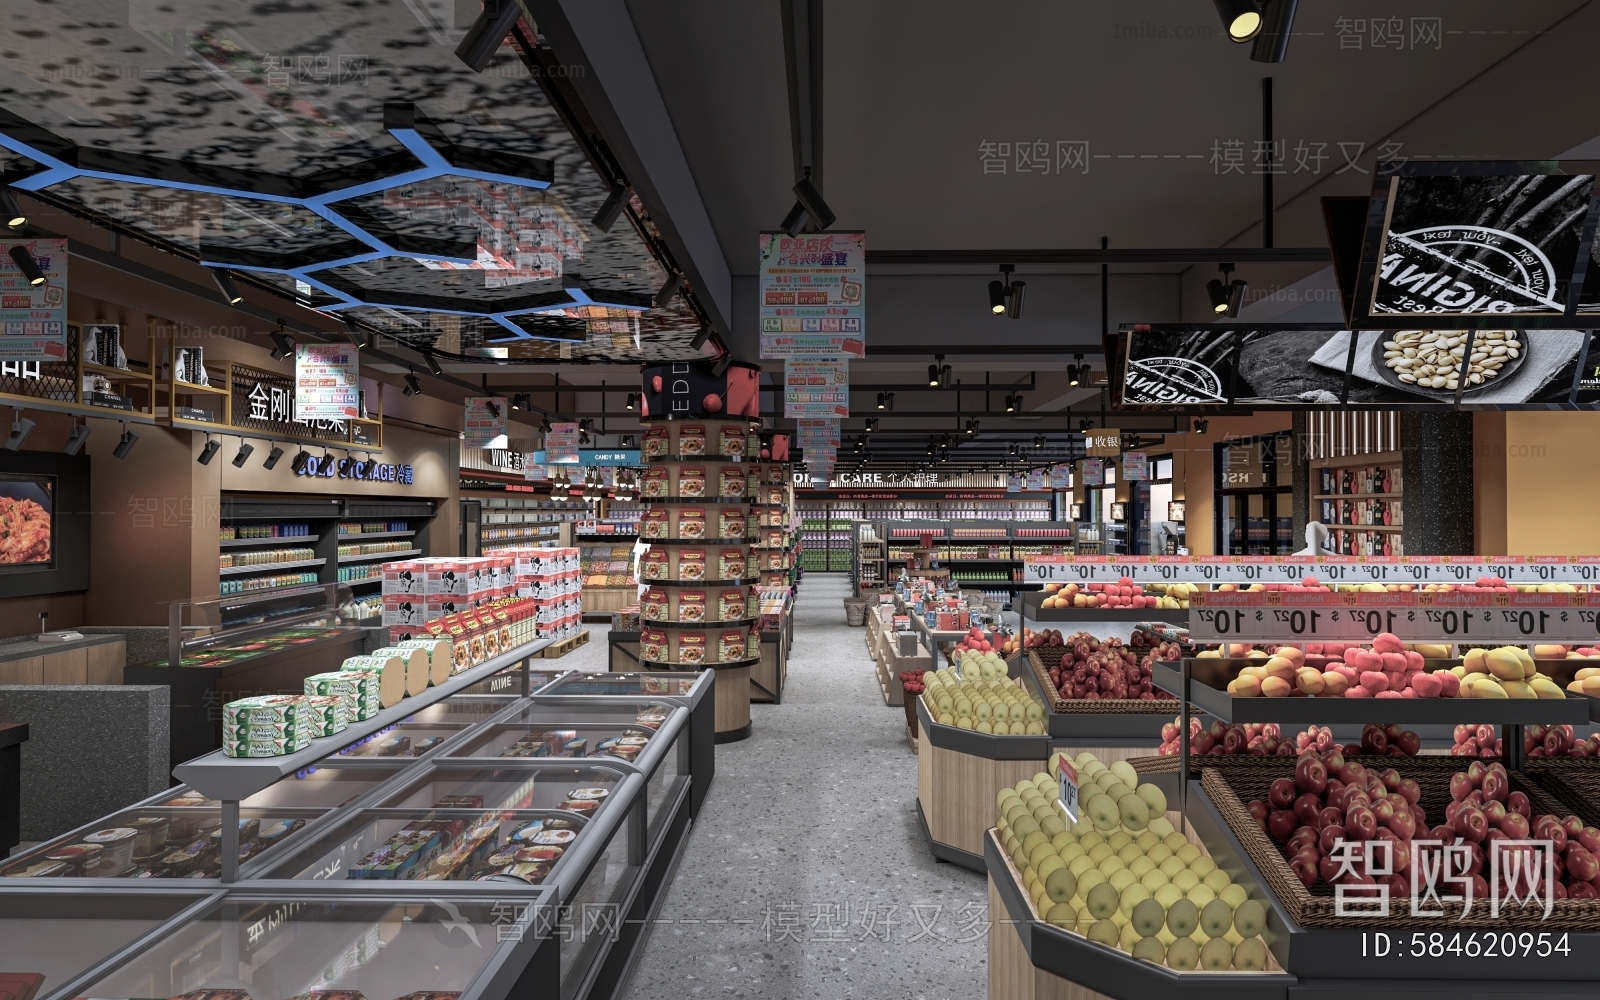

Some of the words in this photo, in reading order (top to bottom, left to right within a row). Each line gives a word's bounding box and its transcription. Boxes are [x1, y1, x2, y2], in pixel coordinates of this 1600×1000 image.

[1095, 436, 1118, 447] 收银
[491, 449, 513, 468] WINE
[840, 472, 883, 483] CARE
